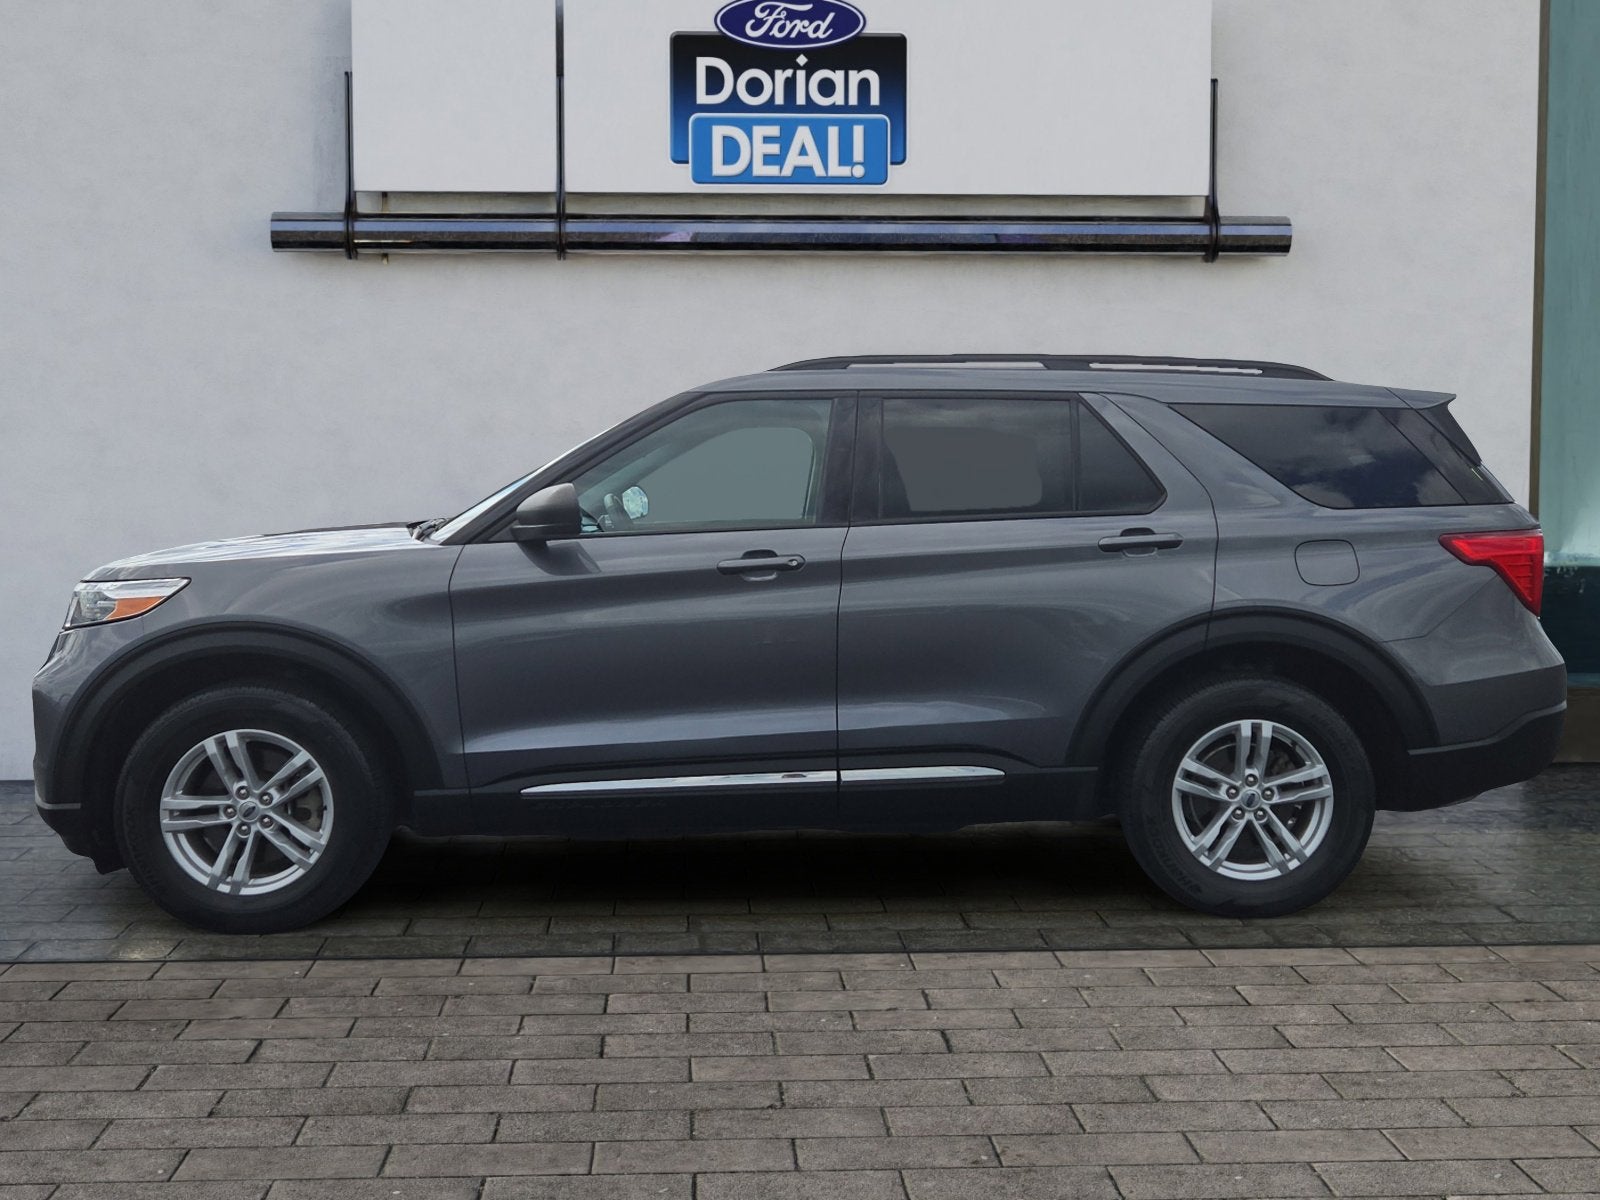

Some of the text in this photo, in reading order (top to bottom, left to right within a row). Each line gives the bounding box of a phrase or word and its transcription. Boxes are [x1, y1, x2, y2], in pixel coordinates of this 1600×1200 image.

[745, 1, 836, 39] Ford
[695, 53, 880, 106] Dorian
[711, 124, 866, 178] DEAL!
